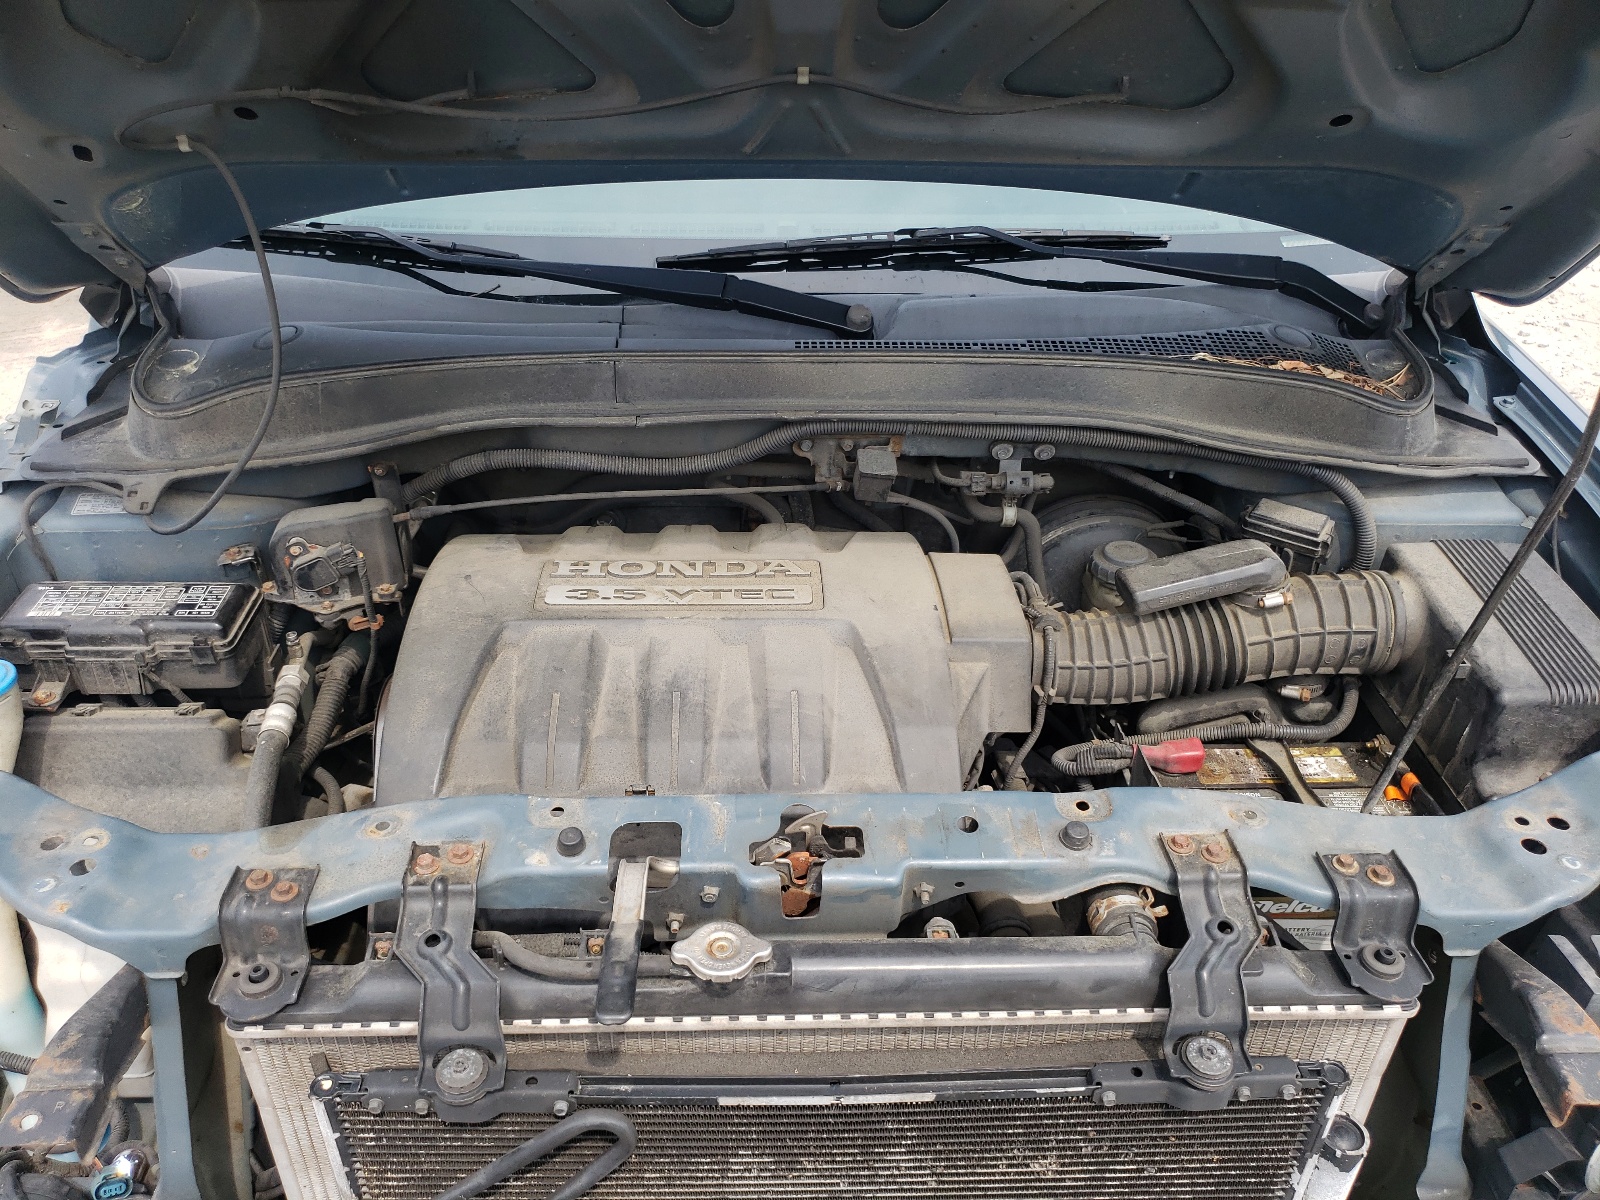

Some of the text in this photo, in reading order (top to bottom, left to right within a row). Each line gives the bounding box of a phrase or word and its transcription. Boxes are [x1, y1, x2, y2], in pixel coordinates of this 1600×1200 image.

[551, 560, 811, 578] HONDA
[565, 588, 796, 600] 3.5 VTEC
